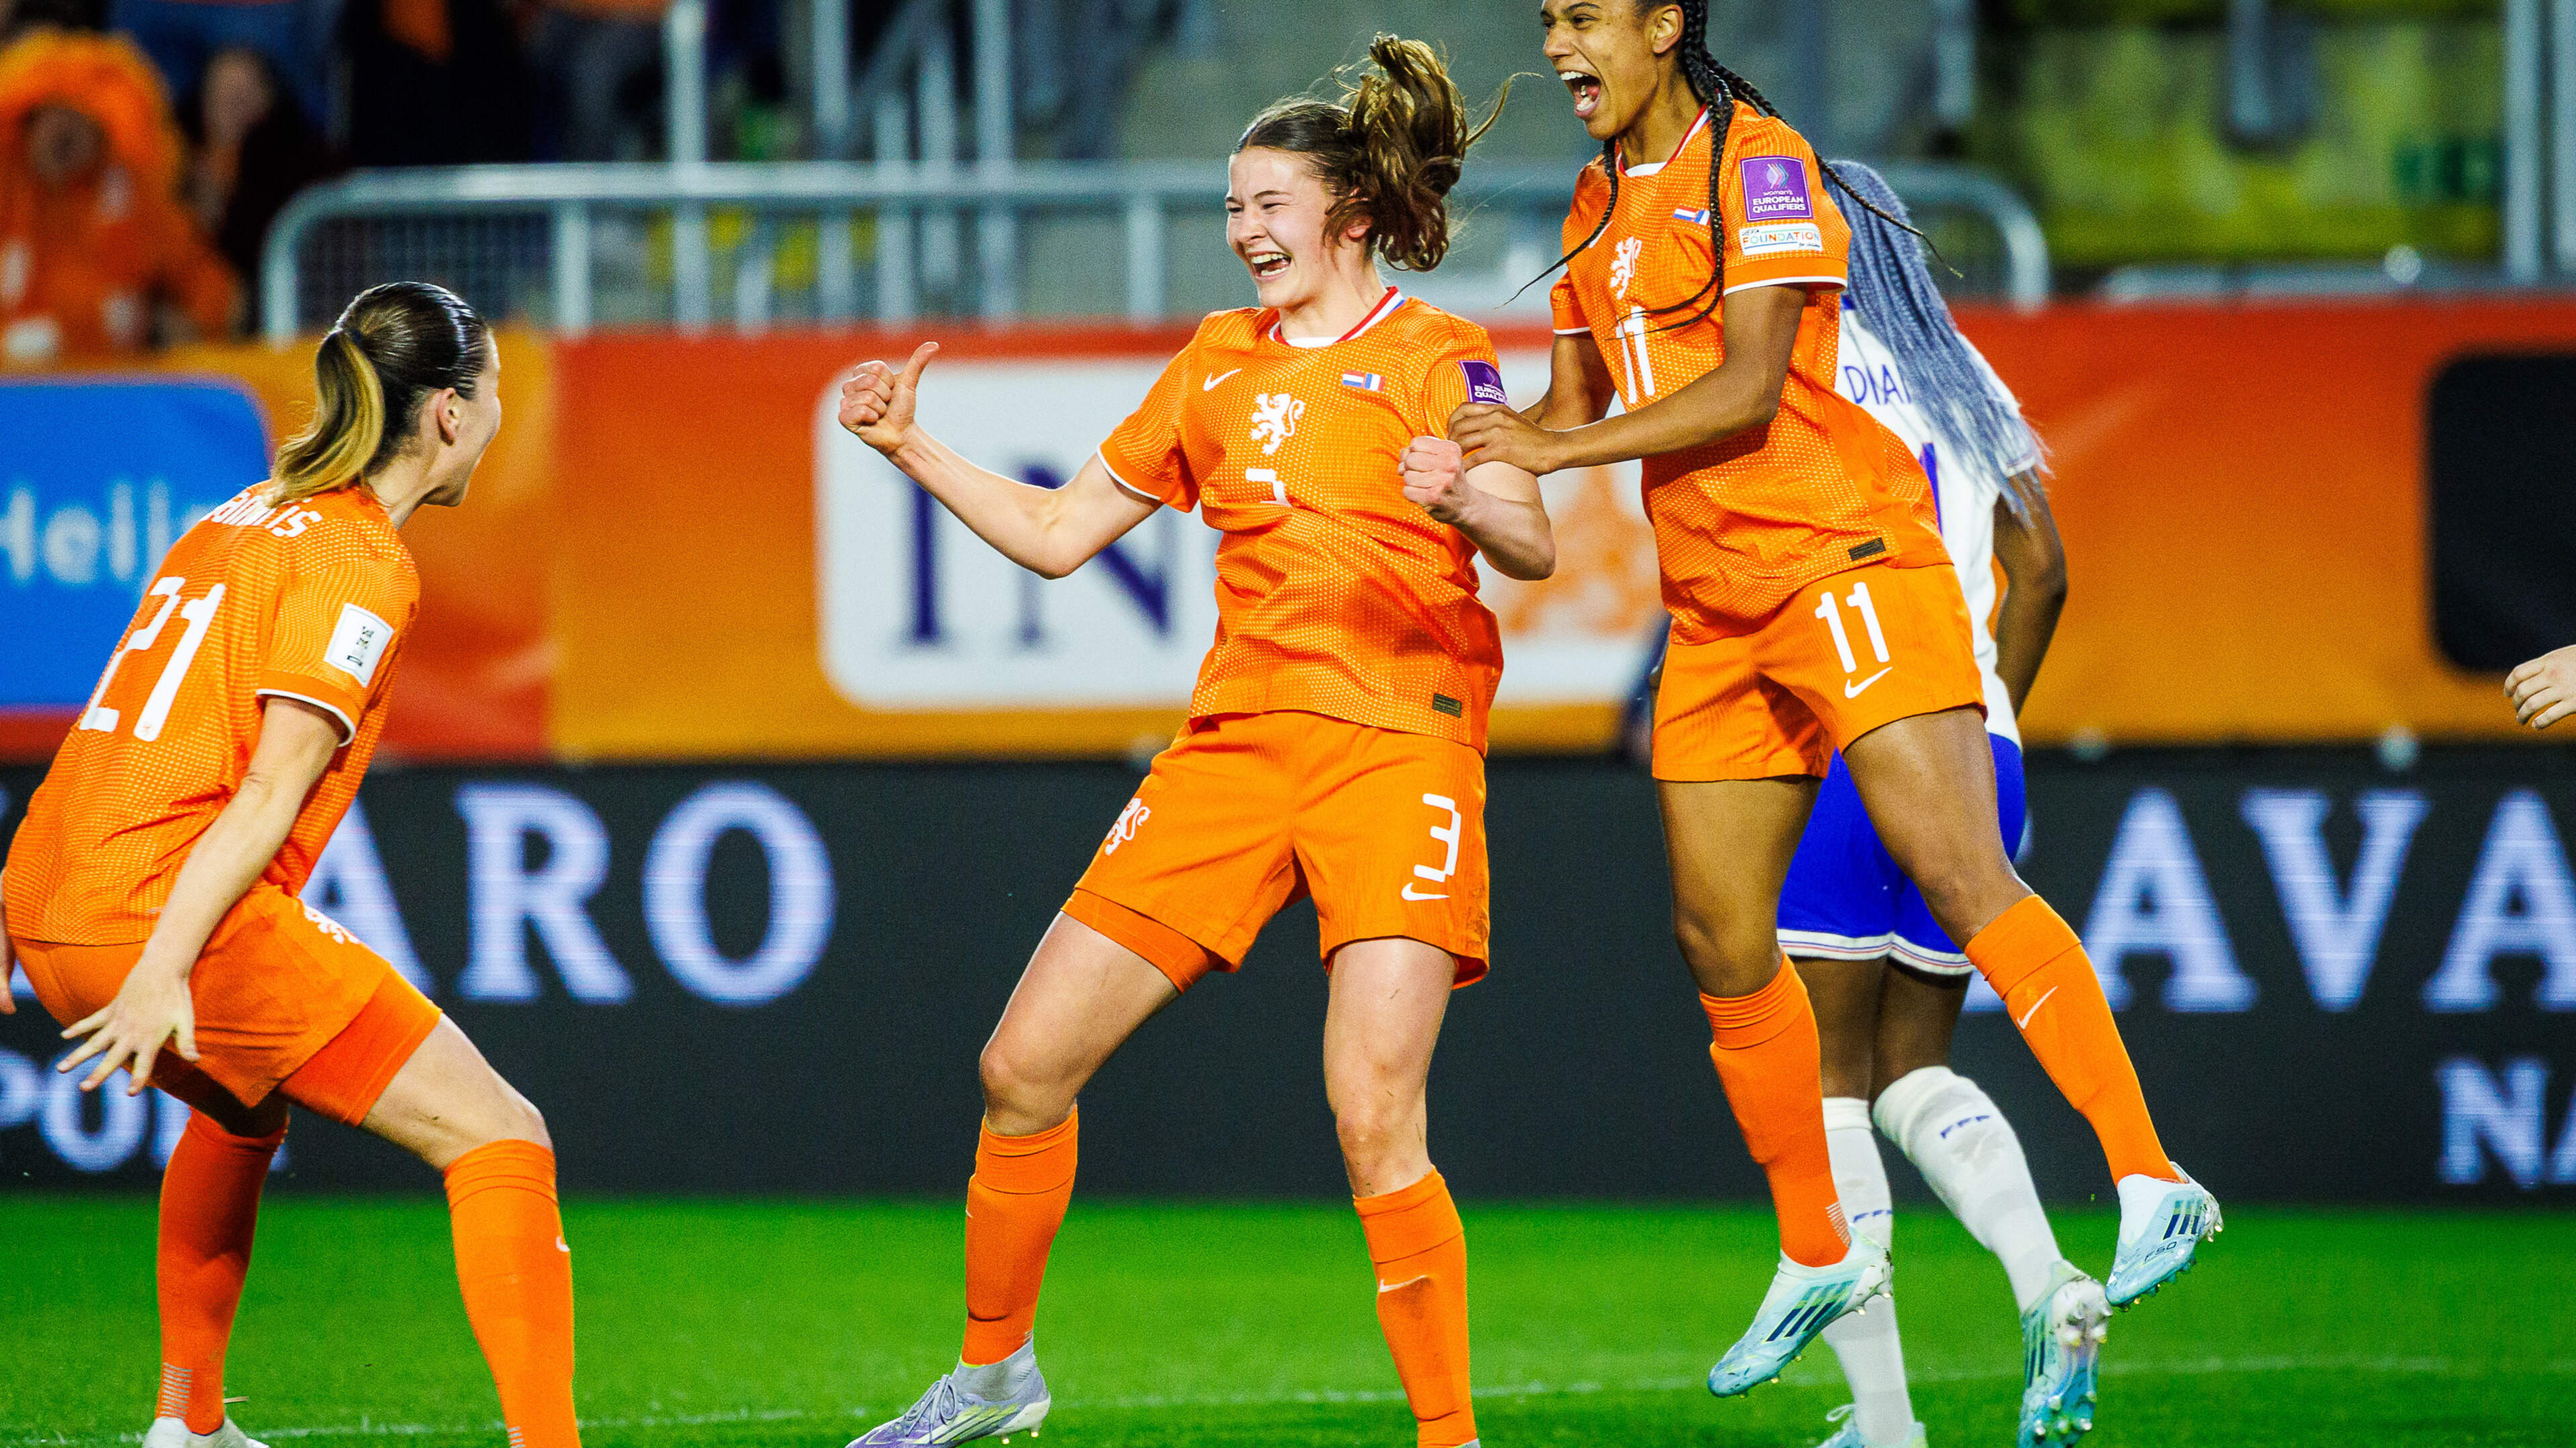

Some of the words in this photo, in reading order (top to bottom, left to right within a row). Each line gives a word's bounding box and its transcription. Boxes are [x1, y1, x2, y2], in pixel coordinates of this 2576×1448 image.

[1752, 196, 1804, 206] EUROPEAN
[1752, 203, 1806, 214] QUALIFIERS
[1615, 305, 1656, 404] 11
[1843, 364, 1912, 404] DIA
[79, 576, 226, 742] 21
[1815, 581, 1890, 673] 11
[1413, 793, 1462, 883] 3
[295, 781, 837, 1007] ARO
[1962, 785, 2576, 1013] AVA
[2438, 1056, 2576, 1187] N
